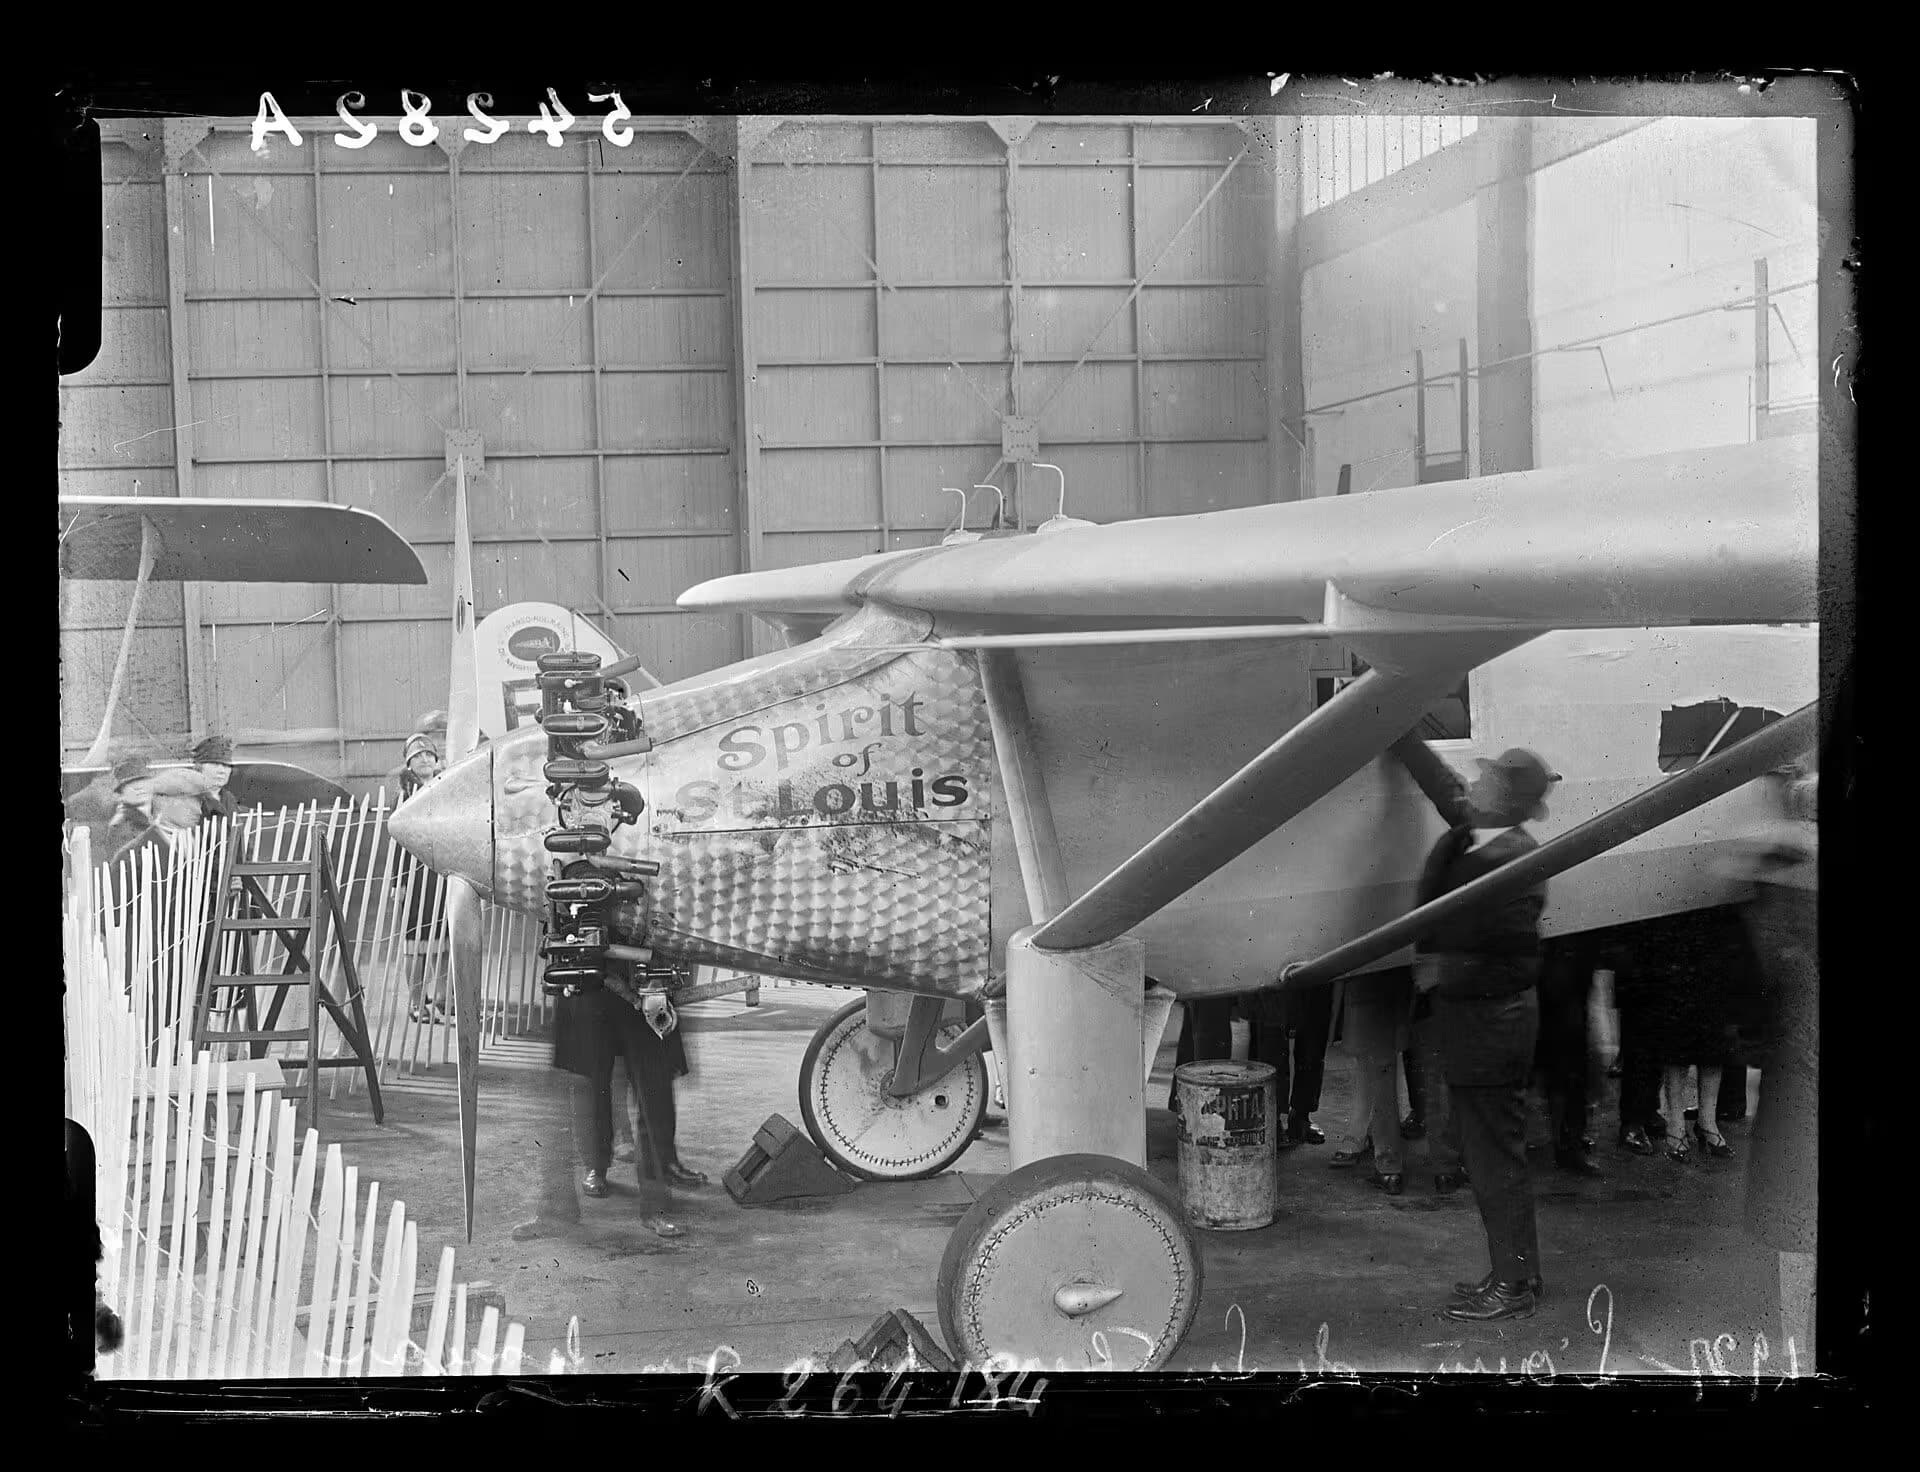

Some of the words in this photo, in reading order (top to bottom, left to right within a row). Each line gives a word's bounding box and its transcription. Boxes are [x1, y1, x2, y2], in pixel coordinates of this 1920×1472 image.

[717, 691, 926, 772] Spirit
[832, 742, 883, 777] of
[778, 768, 969, 817] Louis
